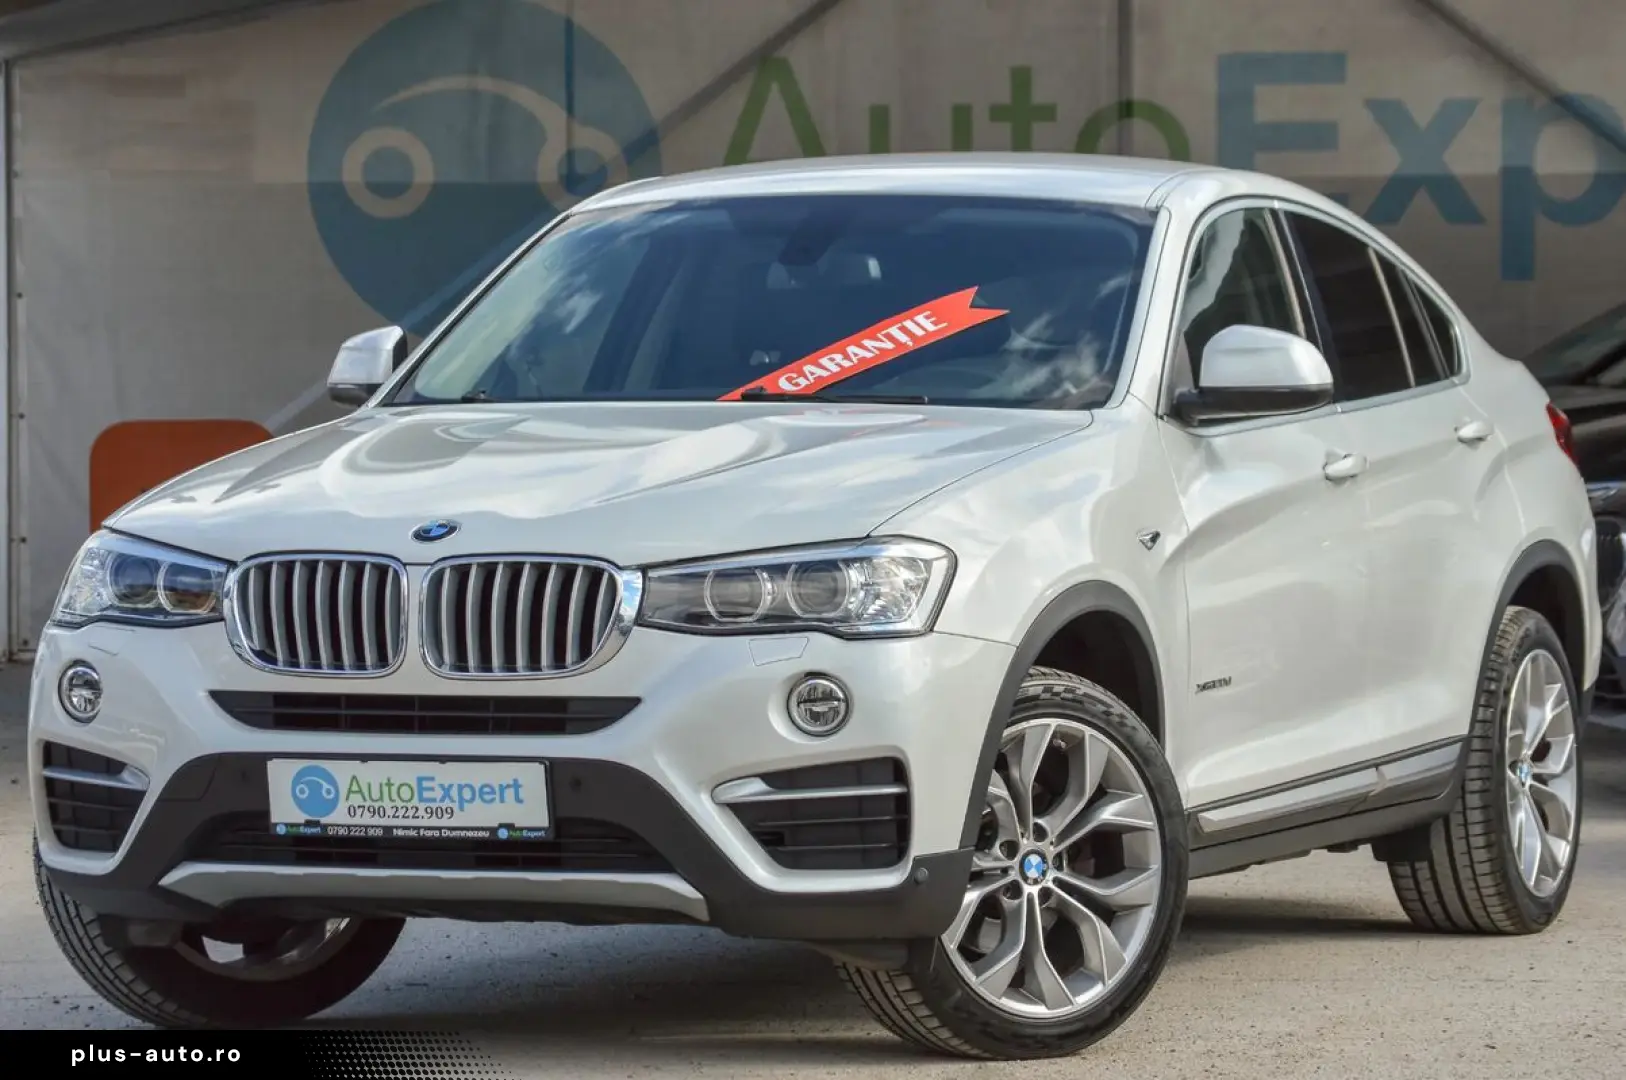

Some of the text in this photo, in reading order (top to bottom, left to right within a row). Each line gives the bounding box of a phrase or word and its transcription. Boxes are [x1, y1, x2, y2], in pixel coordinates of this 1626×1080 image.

[345, 774, 524, 811] AutoExpert
[347, 804, 455, 820] 0790.222.909
[327, 825, 383, 836] 0790 222 909
[393, 827, 418, 836] Nimic
